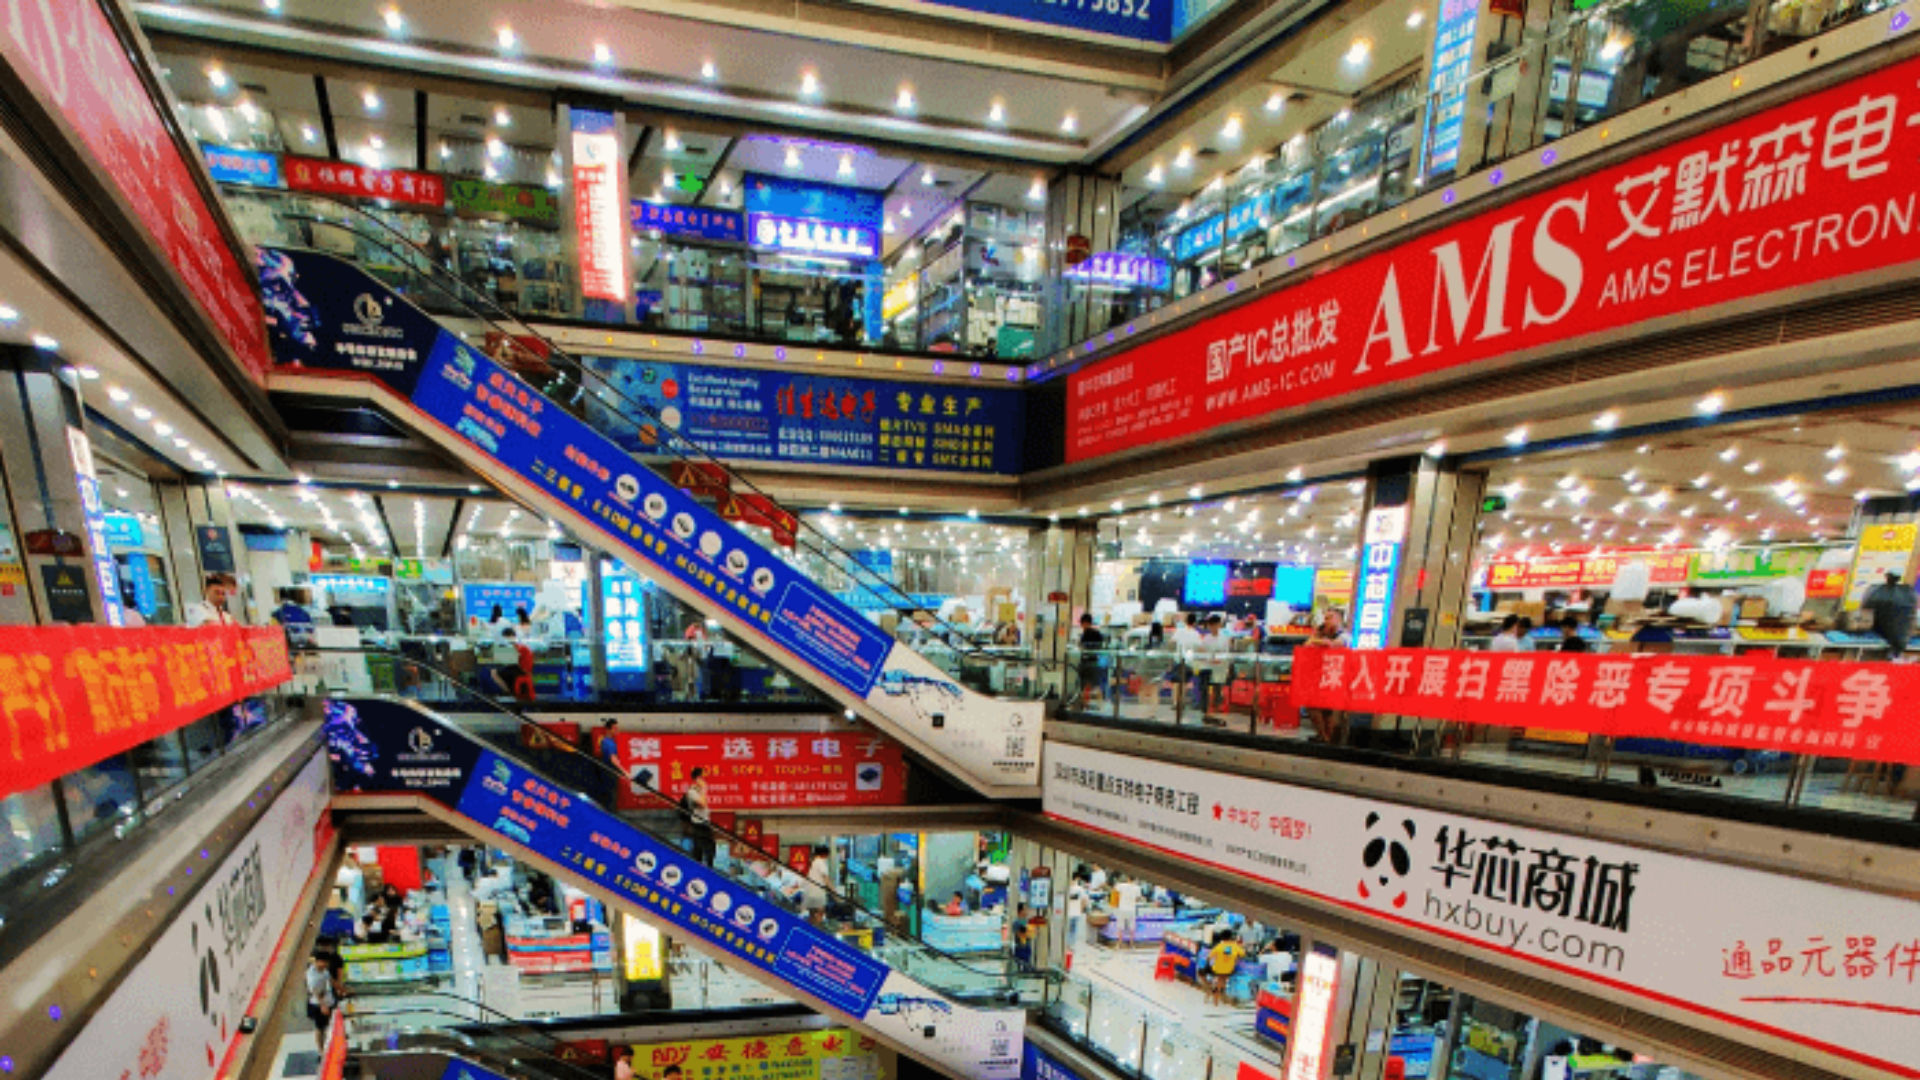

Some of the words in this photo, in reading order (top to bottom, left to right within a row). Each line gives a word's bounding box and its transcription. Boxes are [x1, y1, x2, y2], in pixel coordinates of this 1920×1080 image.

[1606, 92, 1920, 251] 艾默森电
[1355, 191, 1590, 377] AMS
[1598, 258, 1671, 310] AMS
[1680, 193, 1920, 289] ELECTRON
[1206, 299, 1340, 384] 国产IC总批发
[897, 391, 982, 417] 专业生产
[1205, 361, 1335, 411] WWW.AMS-IC.COM
[1319, 653, 1892, 729] 深入开展扫黑除恶专项斗争
[628, 737, 884, 759] 第一选择电子
[1054, 761, 1200, 816] 深圳市政府重点支持电子商务工程
[1227, 805, 1261, 831] 中华芯
[1430, 824, 1640, 934] 华芯商城
[1423, 888, 1626, 973] hxbuy.com
